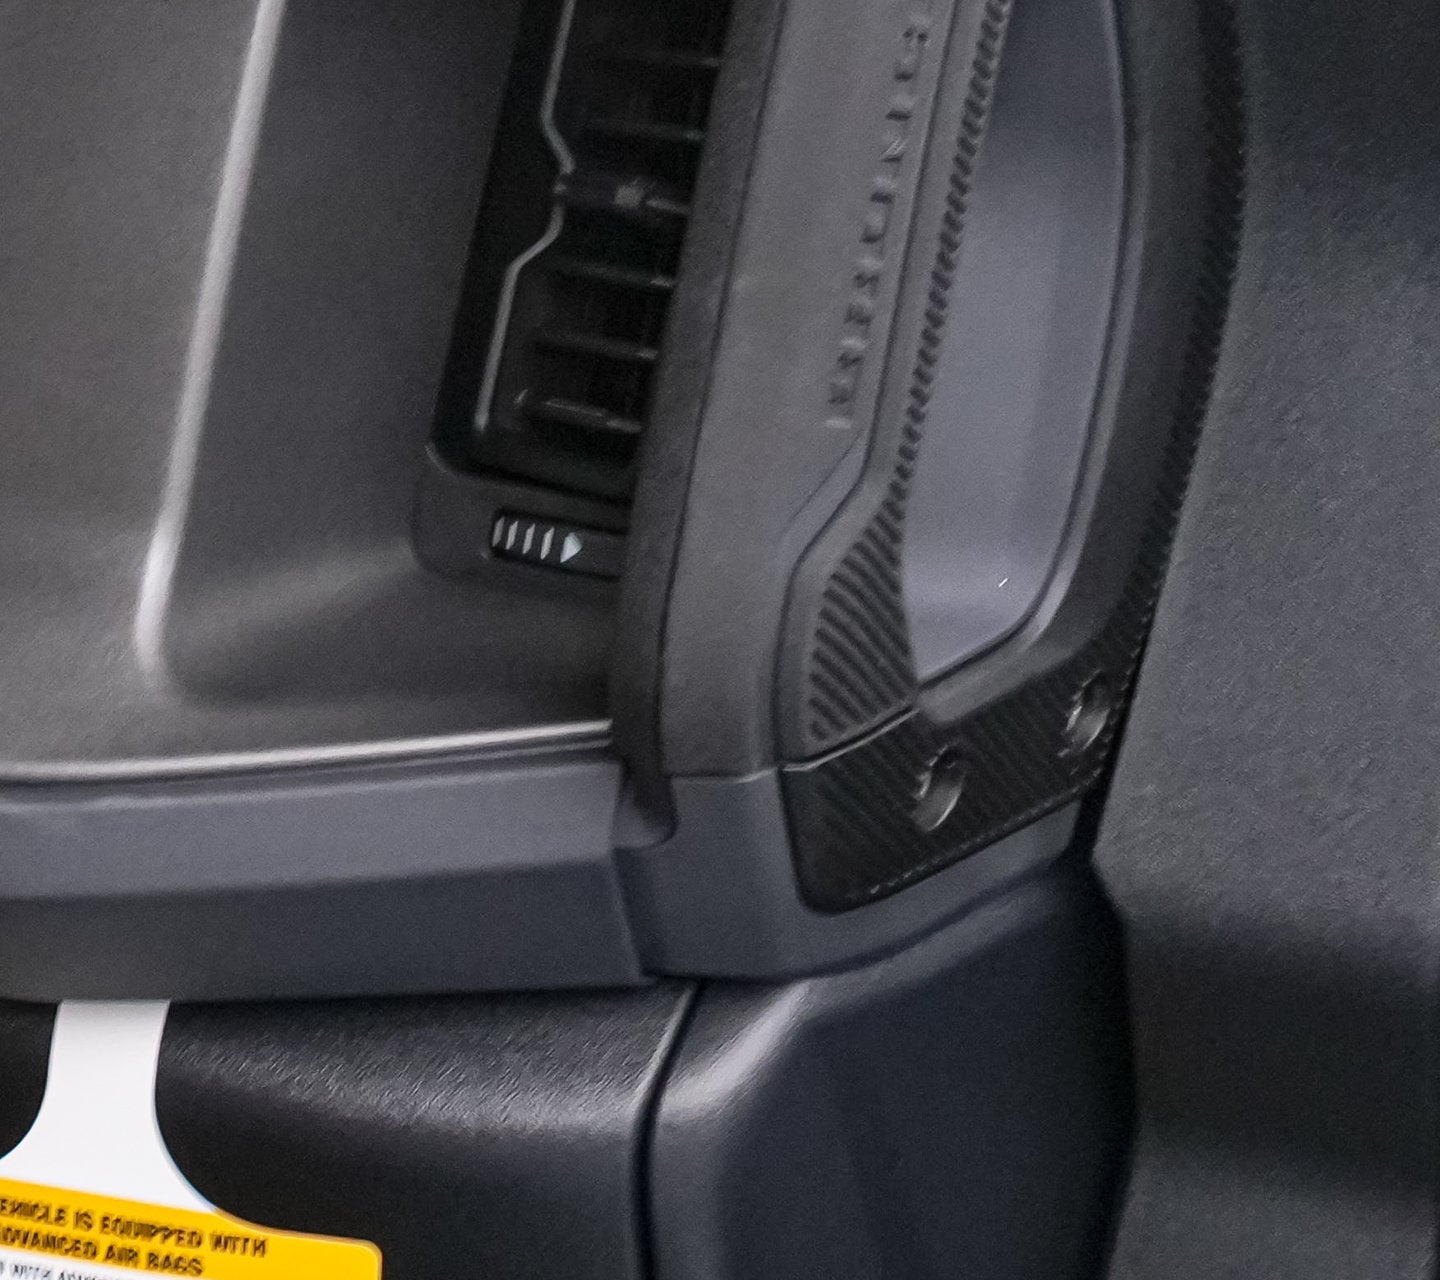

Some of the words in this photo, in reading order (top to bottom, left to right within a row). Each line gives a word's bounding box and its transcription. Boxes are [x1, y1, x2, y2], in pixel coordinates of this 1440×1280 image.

[73, 1210, 92, 1231] IS
[100, 1213, 201, 1247] EQUIPPED
[210, 1230, 267, 1258] WITH
[105, 1244, 138, 1266] AIR
[146, 1250, 203, 1277] BAGS
